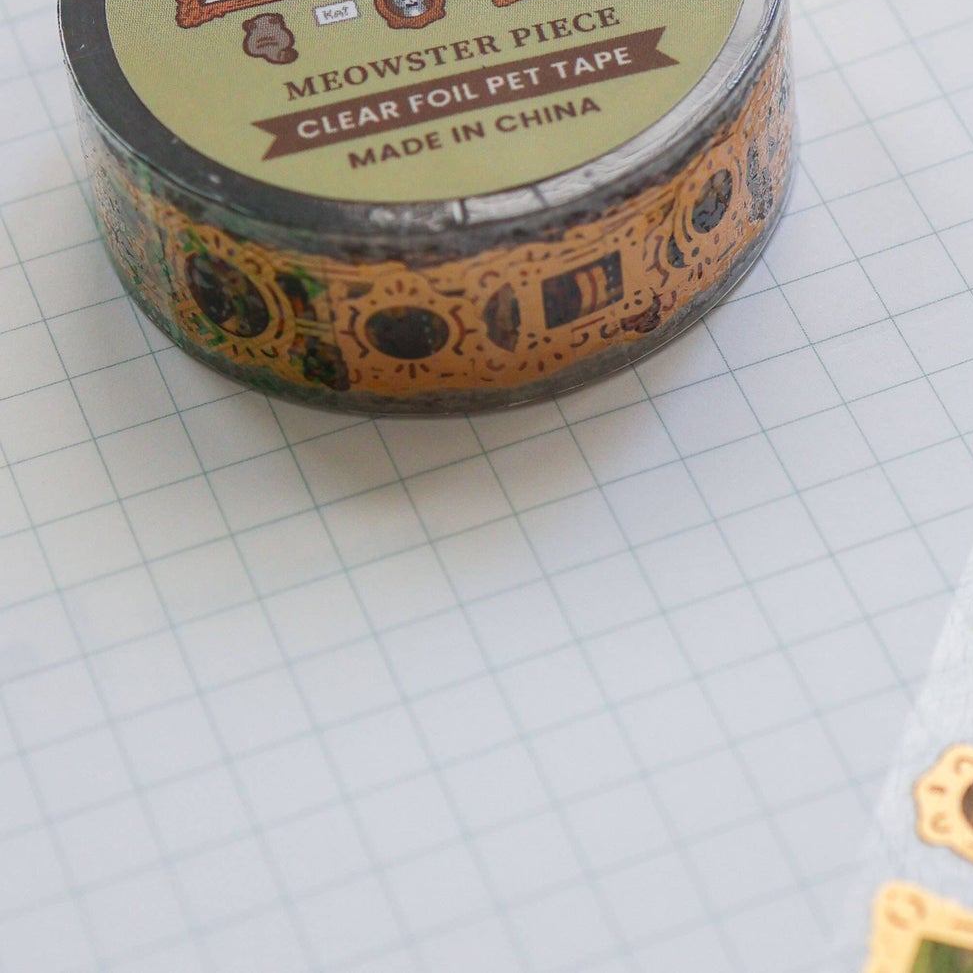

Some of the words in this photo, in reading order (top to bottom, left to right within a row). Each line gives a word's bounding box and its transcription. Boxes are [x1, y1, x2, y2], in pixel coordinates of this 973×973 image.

[283, 35, 502, 101] MEOWSTER
[508, 6, 620, 49] PIECE
[297, 100, 400, 139] CLEAR
[408, 82, 480, 114] FOIL
[486, 67, 541, 96] PET
[551, 46, 633, 80] TAPE
[348, 131, 443, 170] MADE
[451, 121, 486, 144] IN
[495, 96, 602, 133] CHINA
